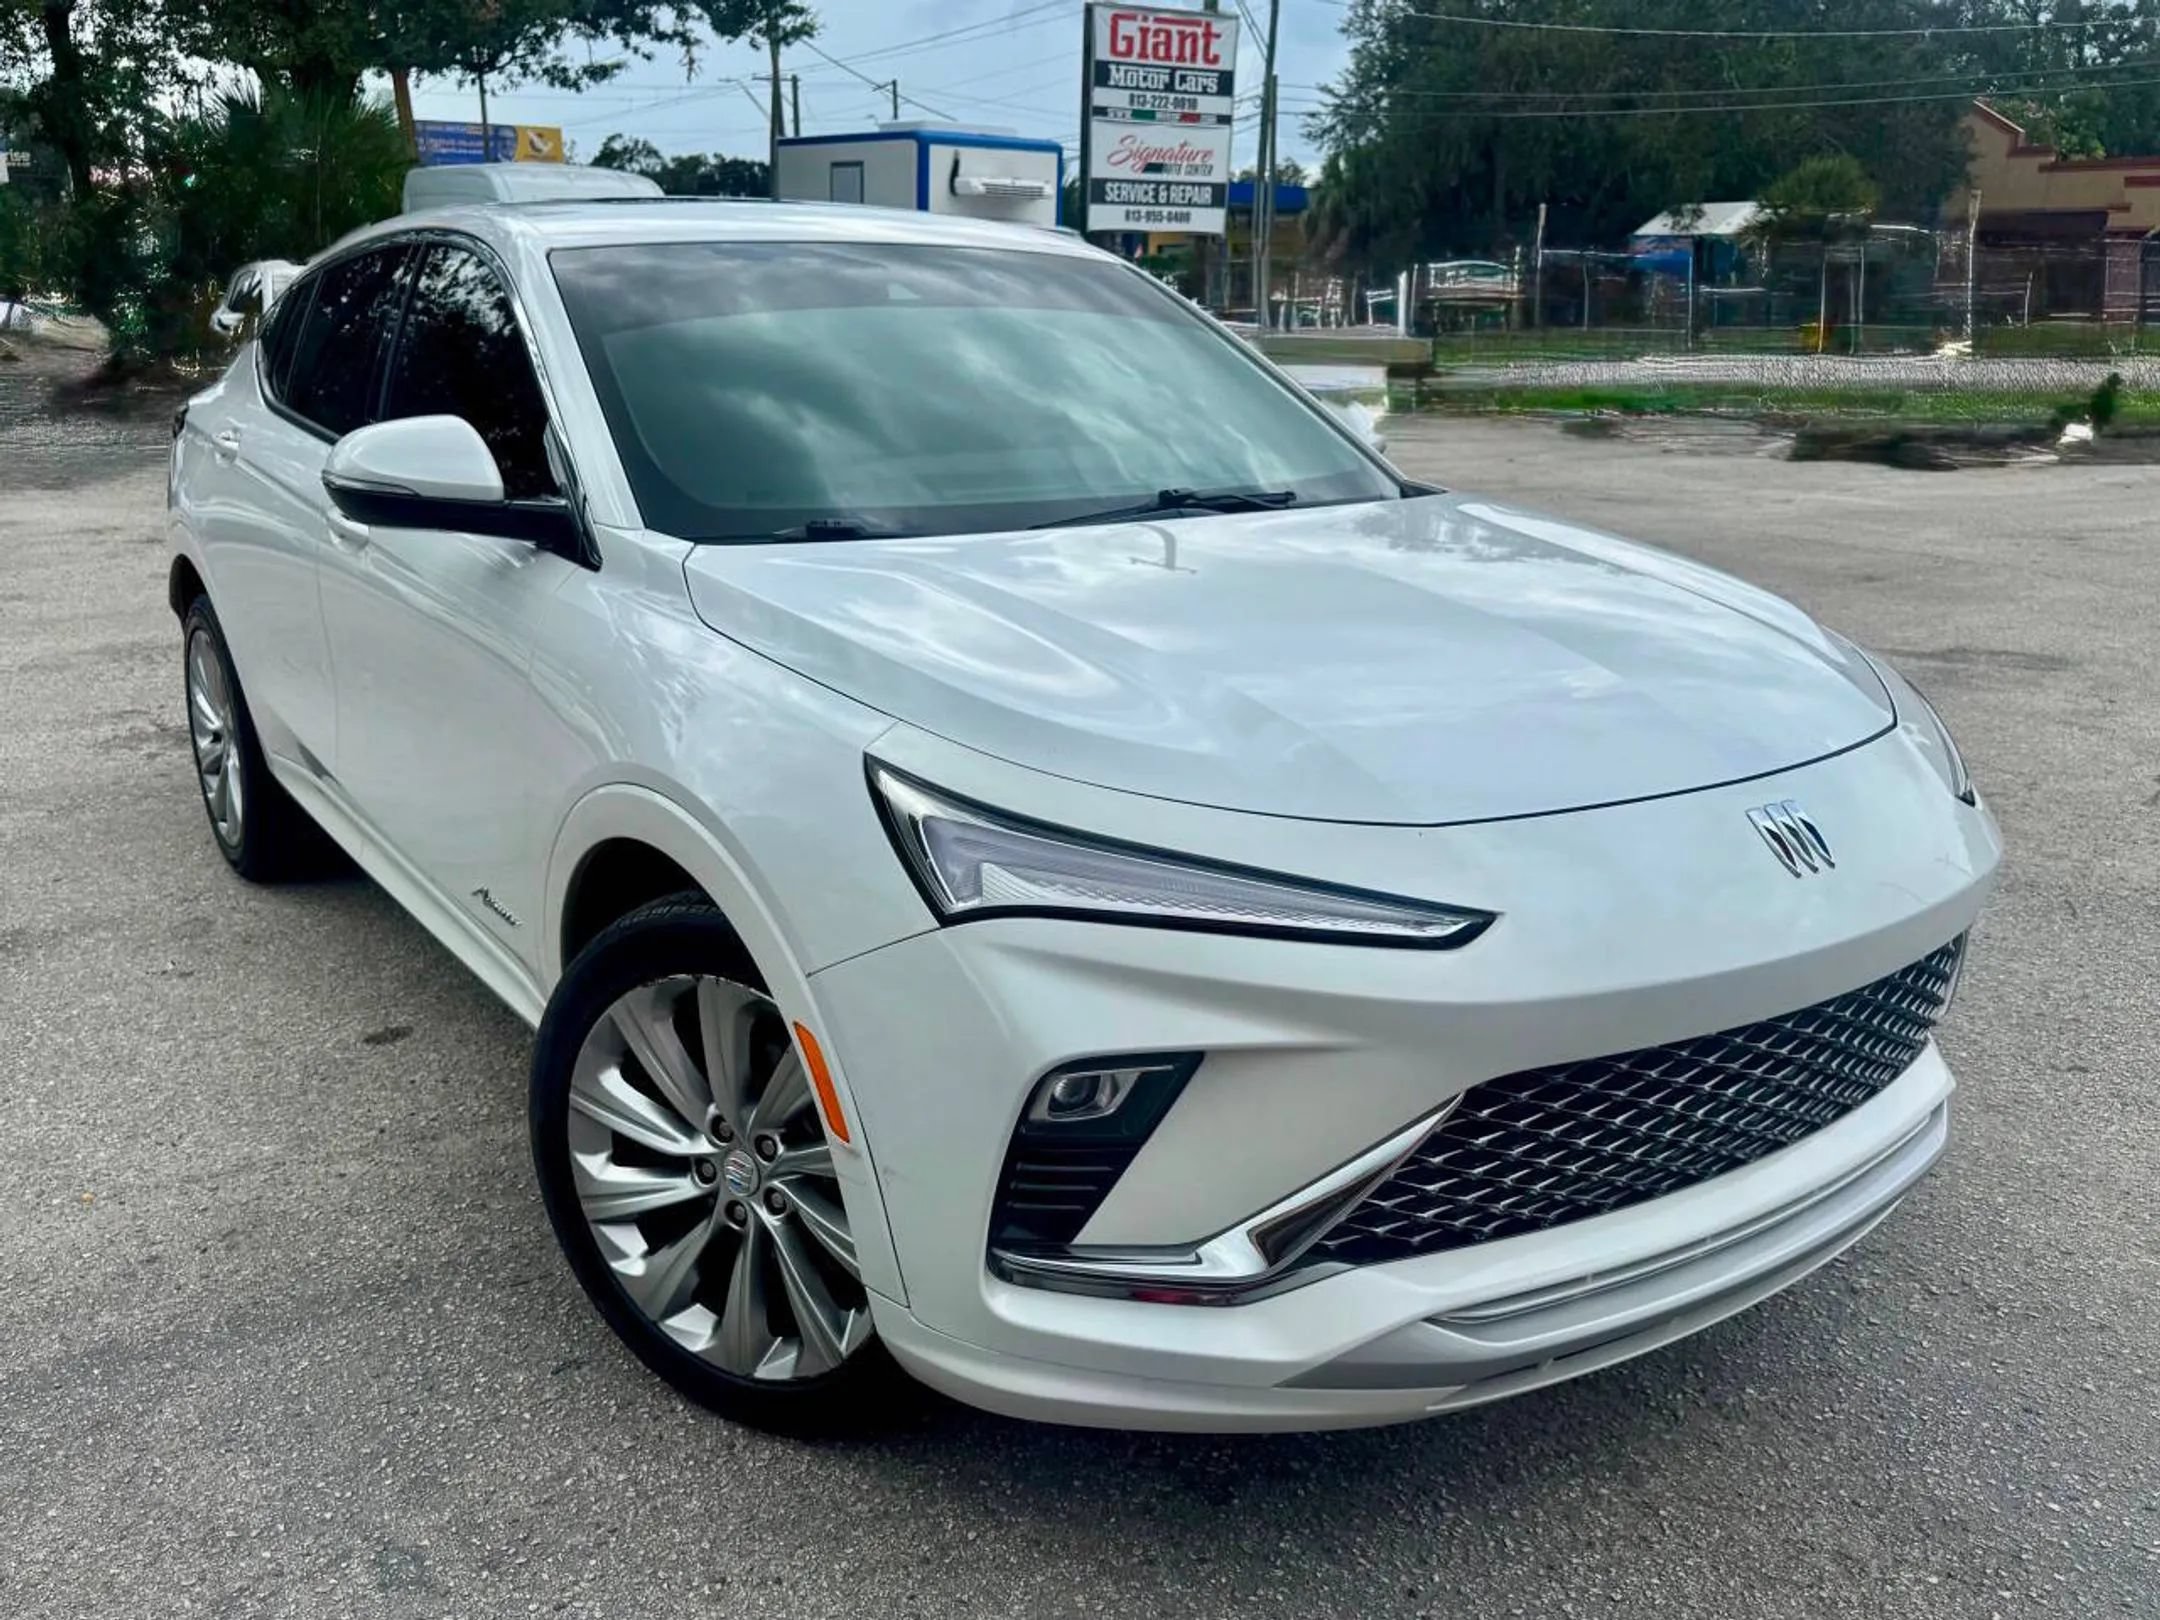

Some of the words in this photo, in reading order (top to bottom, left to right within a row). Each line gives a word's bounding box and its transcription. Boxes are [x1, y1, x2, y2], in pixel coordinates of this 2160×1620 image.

[1109, 12, 1221, 65] Giant
[1108, 64, 1169, 90] Motor
[1174, 70, 1219, 93] Cars
[1107, 134, 1215, 173] Signature
[1104, 183, 1156, 203] SERVICE
[1158, 184, 1168, 204] &
[1170, 185, 1212, 205] REPAIR
